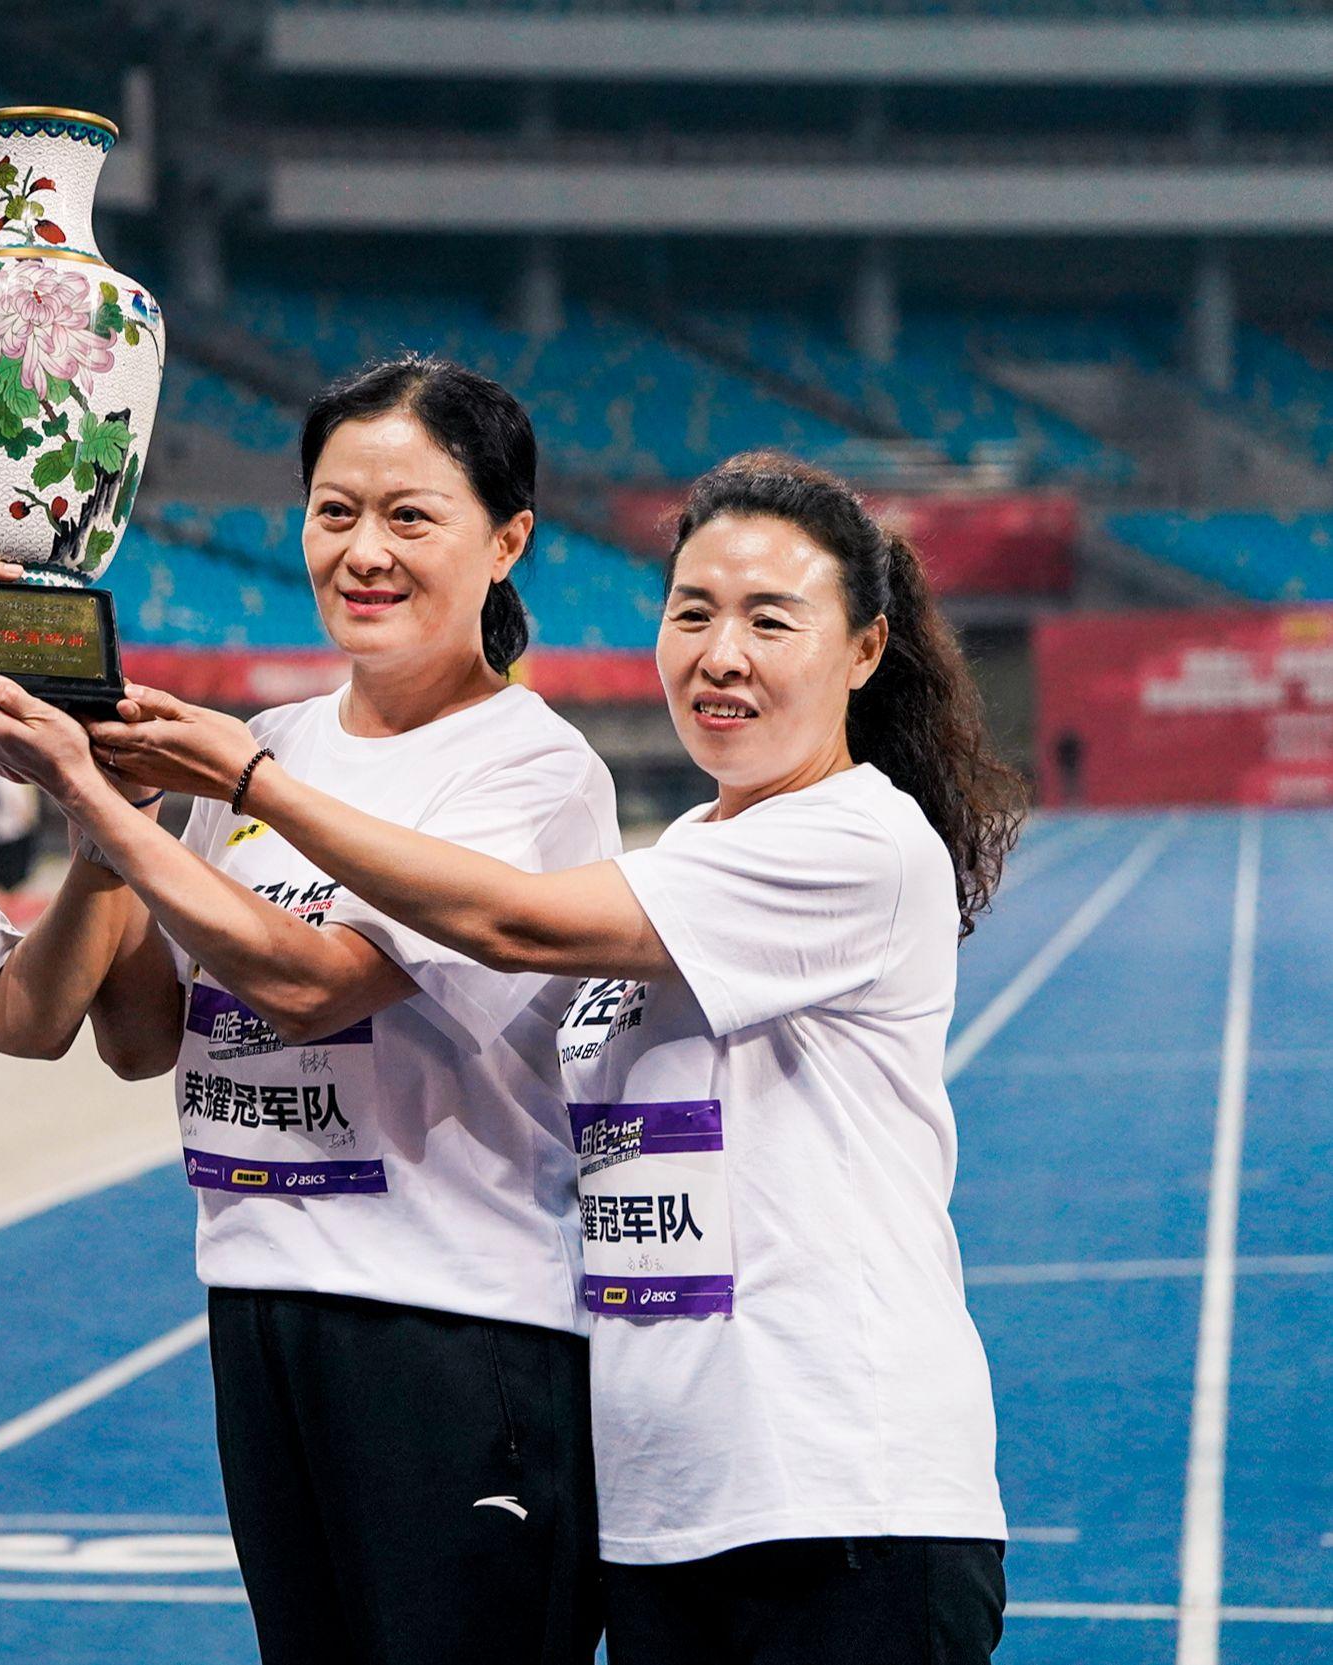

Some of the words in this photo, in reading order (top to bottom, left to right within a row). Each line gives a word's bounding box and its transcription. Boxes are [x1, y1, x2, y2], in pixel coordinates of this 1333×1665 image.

[290, 901, 333, 916] THLETICS
[183, 1069, 350, 1133] 荣耀冠军队
[581, 1116, 644, 1160] 田径之城
